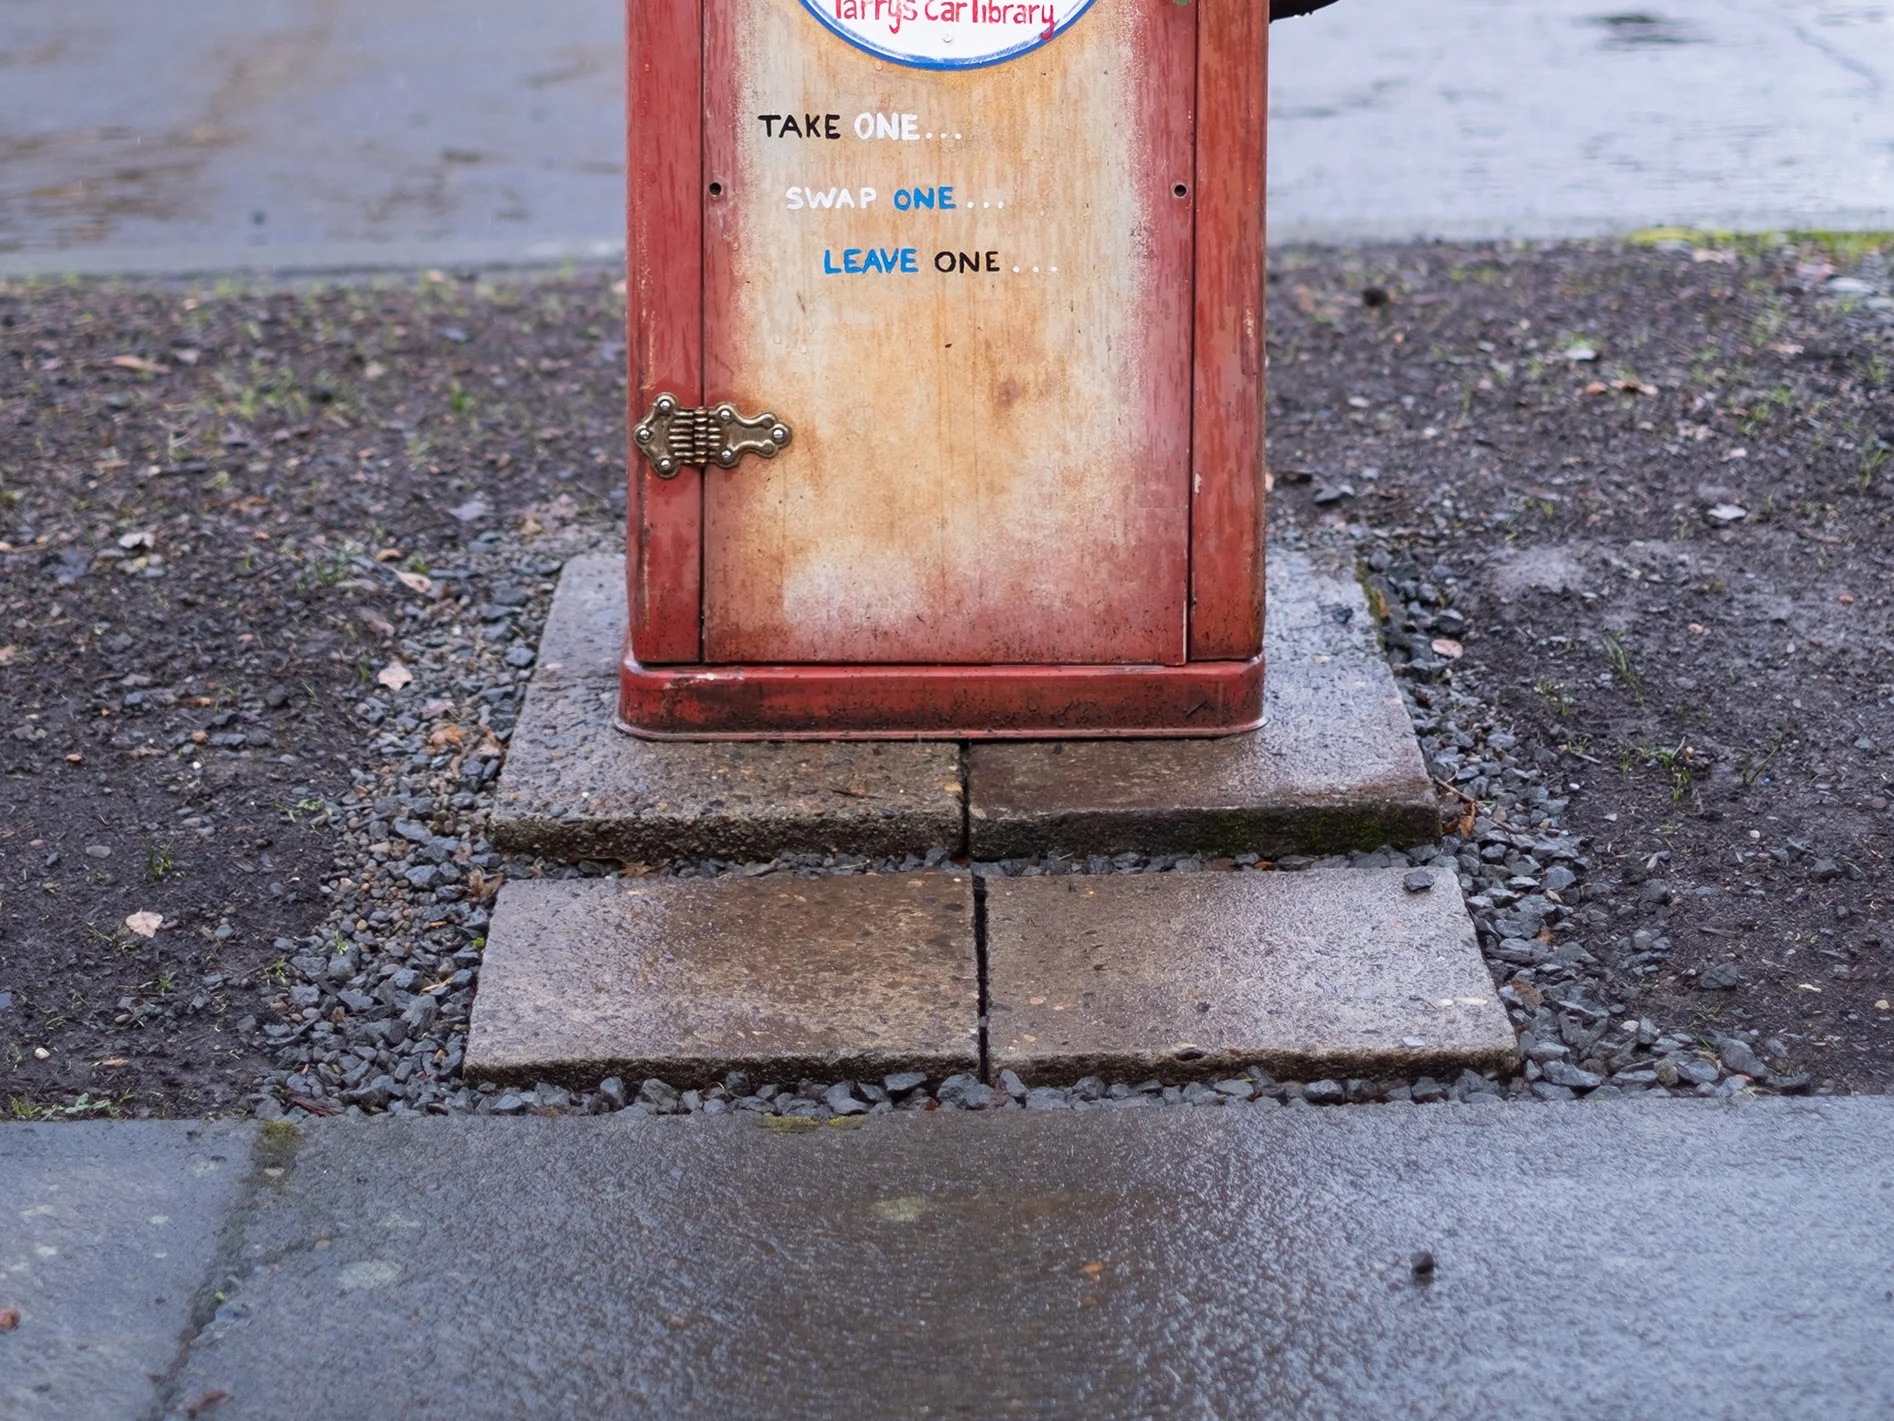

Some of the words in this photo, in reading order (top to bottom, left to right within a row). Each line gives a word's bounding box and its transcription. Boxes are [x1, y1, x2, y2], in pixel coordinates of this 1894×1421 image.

[757, 113, 841, 139] TAKE
[785, 186, 877, 210] SWAP
[823, 247, 919, 275] LEAVE
